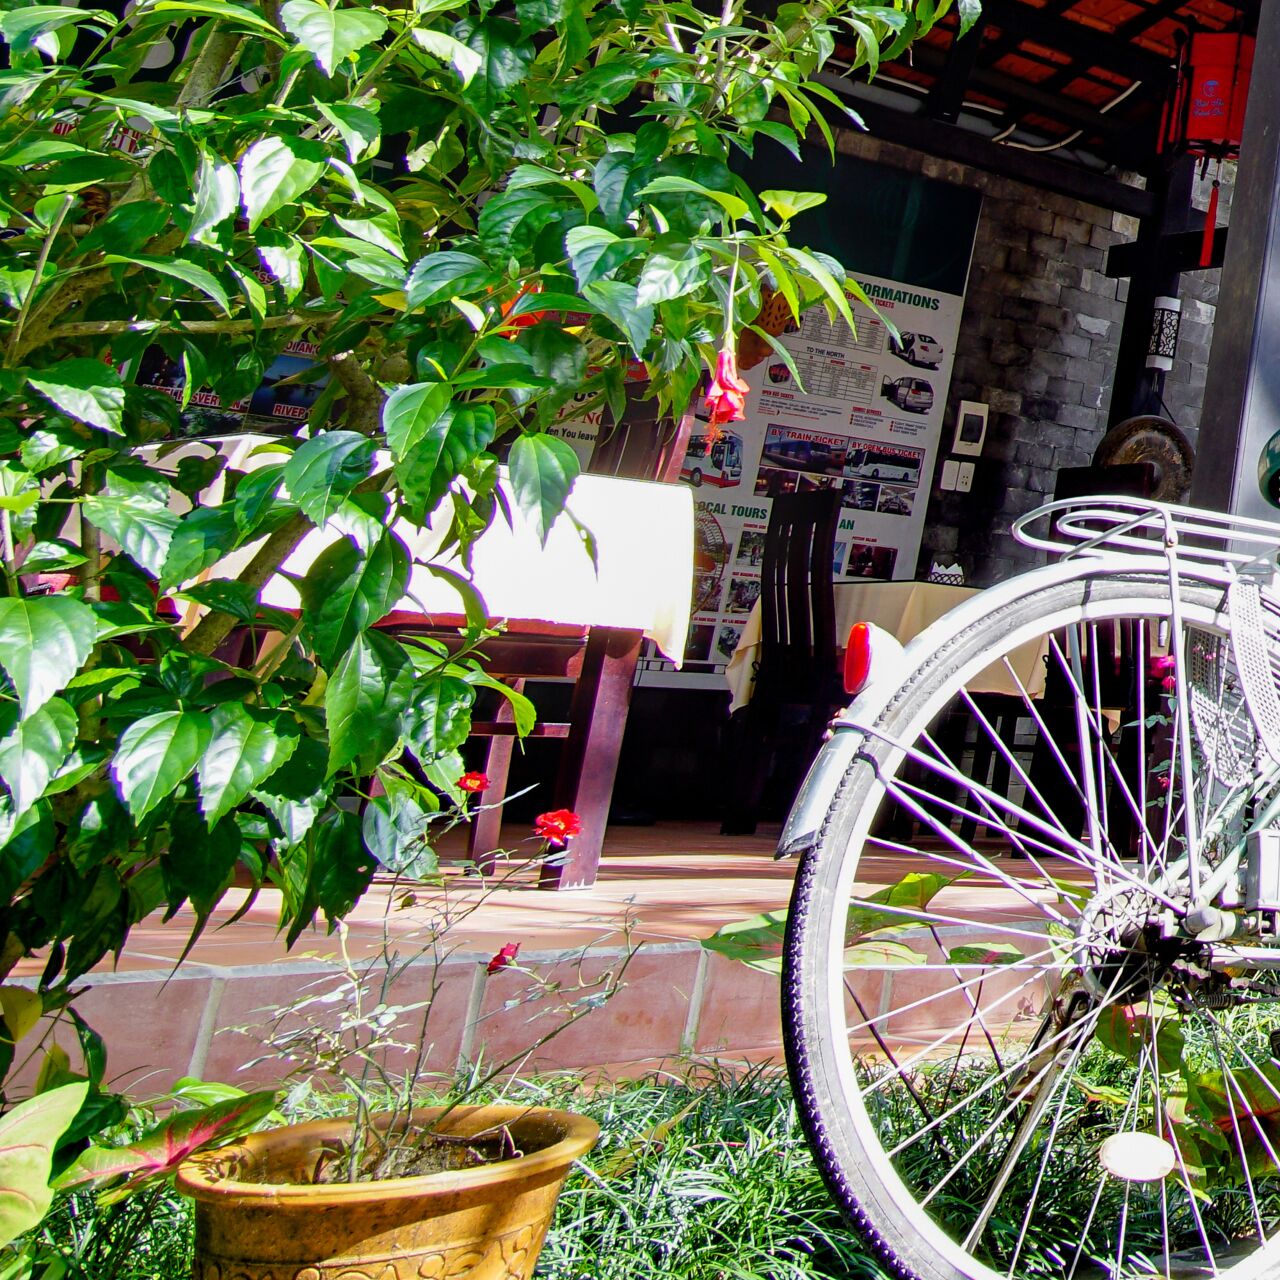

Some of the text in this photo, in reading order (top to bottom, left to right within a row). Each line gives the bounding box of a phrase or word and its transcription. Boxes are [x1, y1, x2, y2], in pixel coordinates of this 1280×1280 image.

[815, 347, 825, 356] THE
[826, 349, 846, 359] NORTH
[561, 428, 577, 439] You
[771, 428, 845, 446] BY TRAIN TICKET
[852, 441, 862, 450] BY
[697, 501, 855, 530] OCAL TOURS AN
